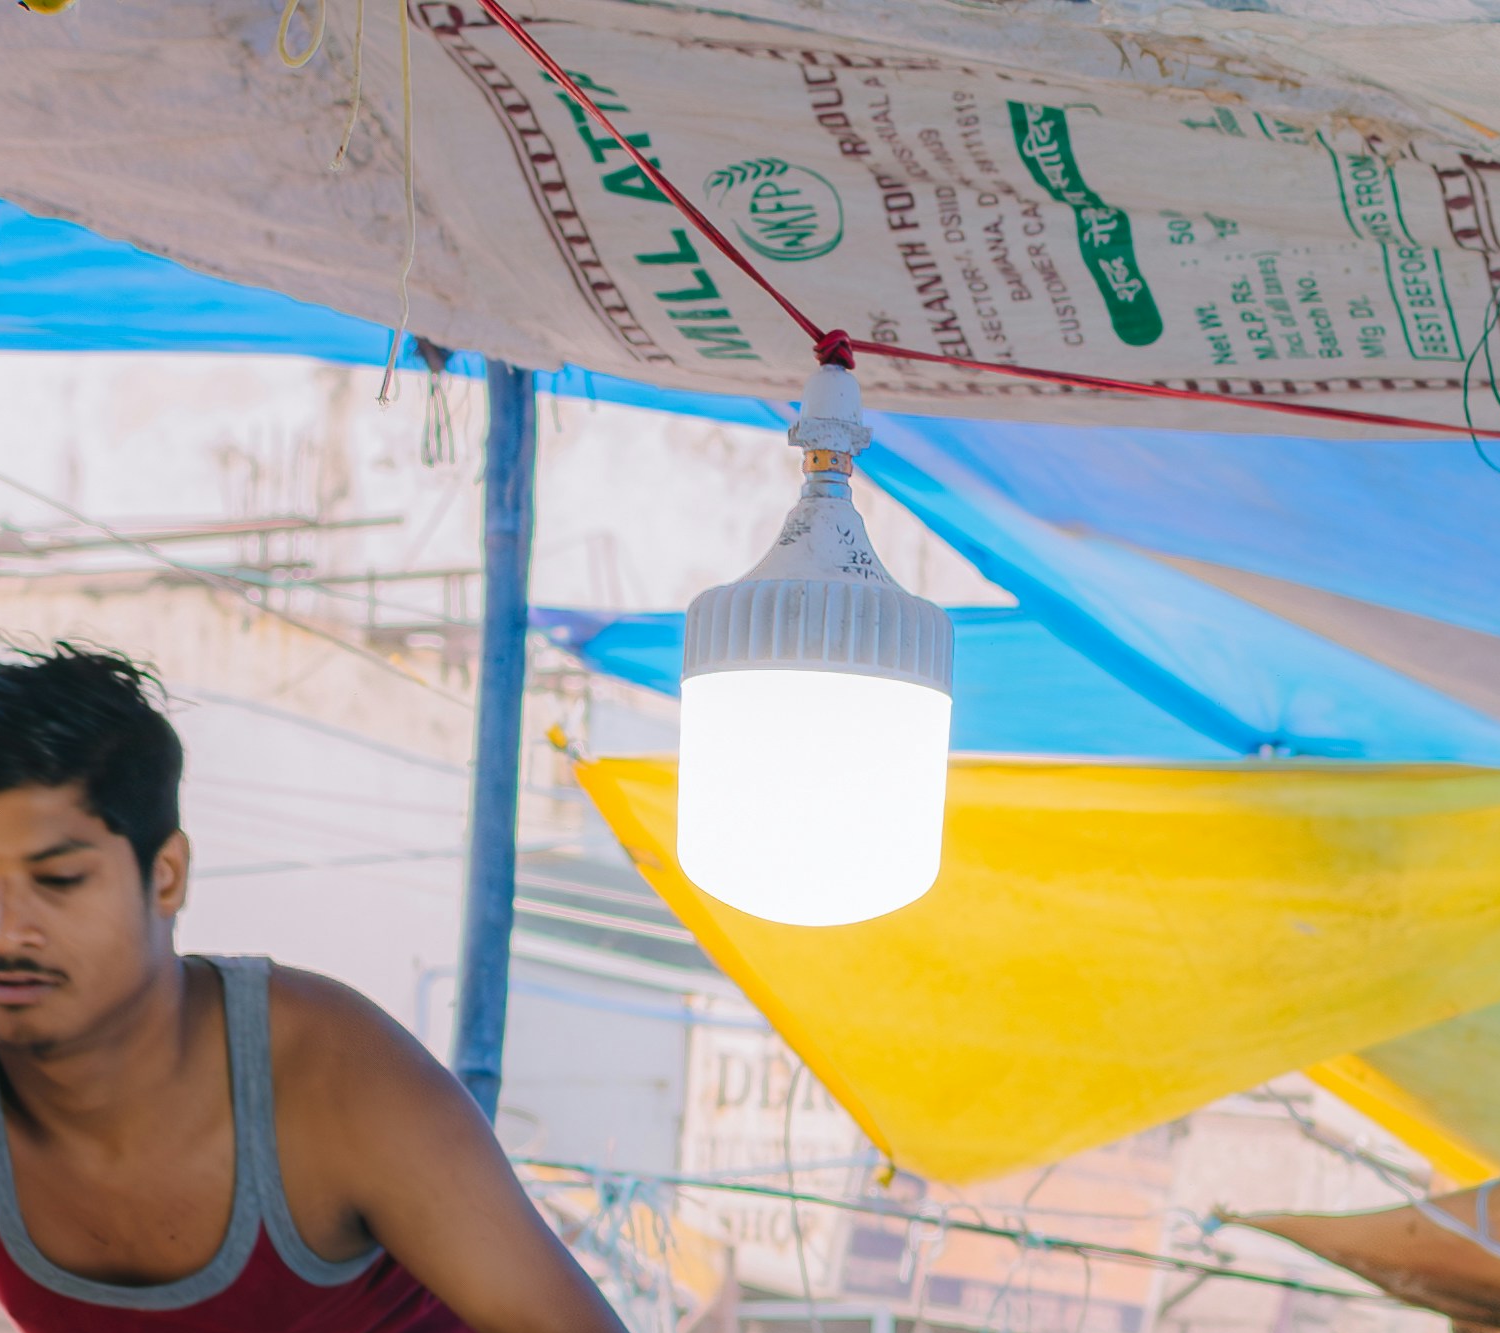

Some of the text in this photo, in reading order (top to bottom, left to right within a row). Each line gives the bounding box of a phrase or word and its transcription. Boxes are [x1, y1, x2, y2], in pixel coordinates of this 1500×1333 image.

[634, 229, 761, 361] MILL
[897, 242, 980, 374] ELKANTH
[1397, 246, 1436, 309] BEFOR
[1308, 307, 1343, 359] Batch
[1415, 312, 1448, 355] BEST
